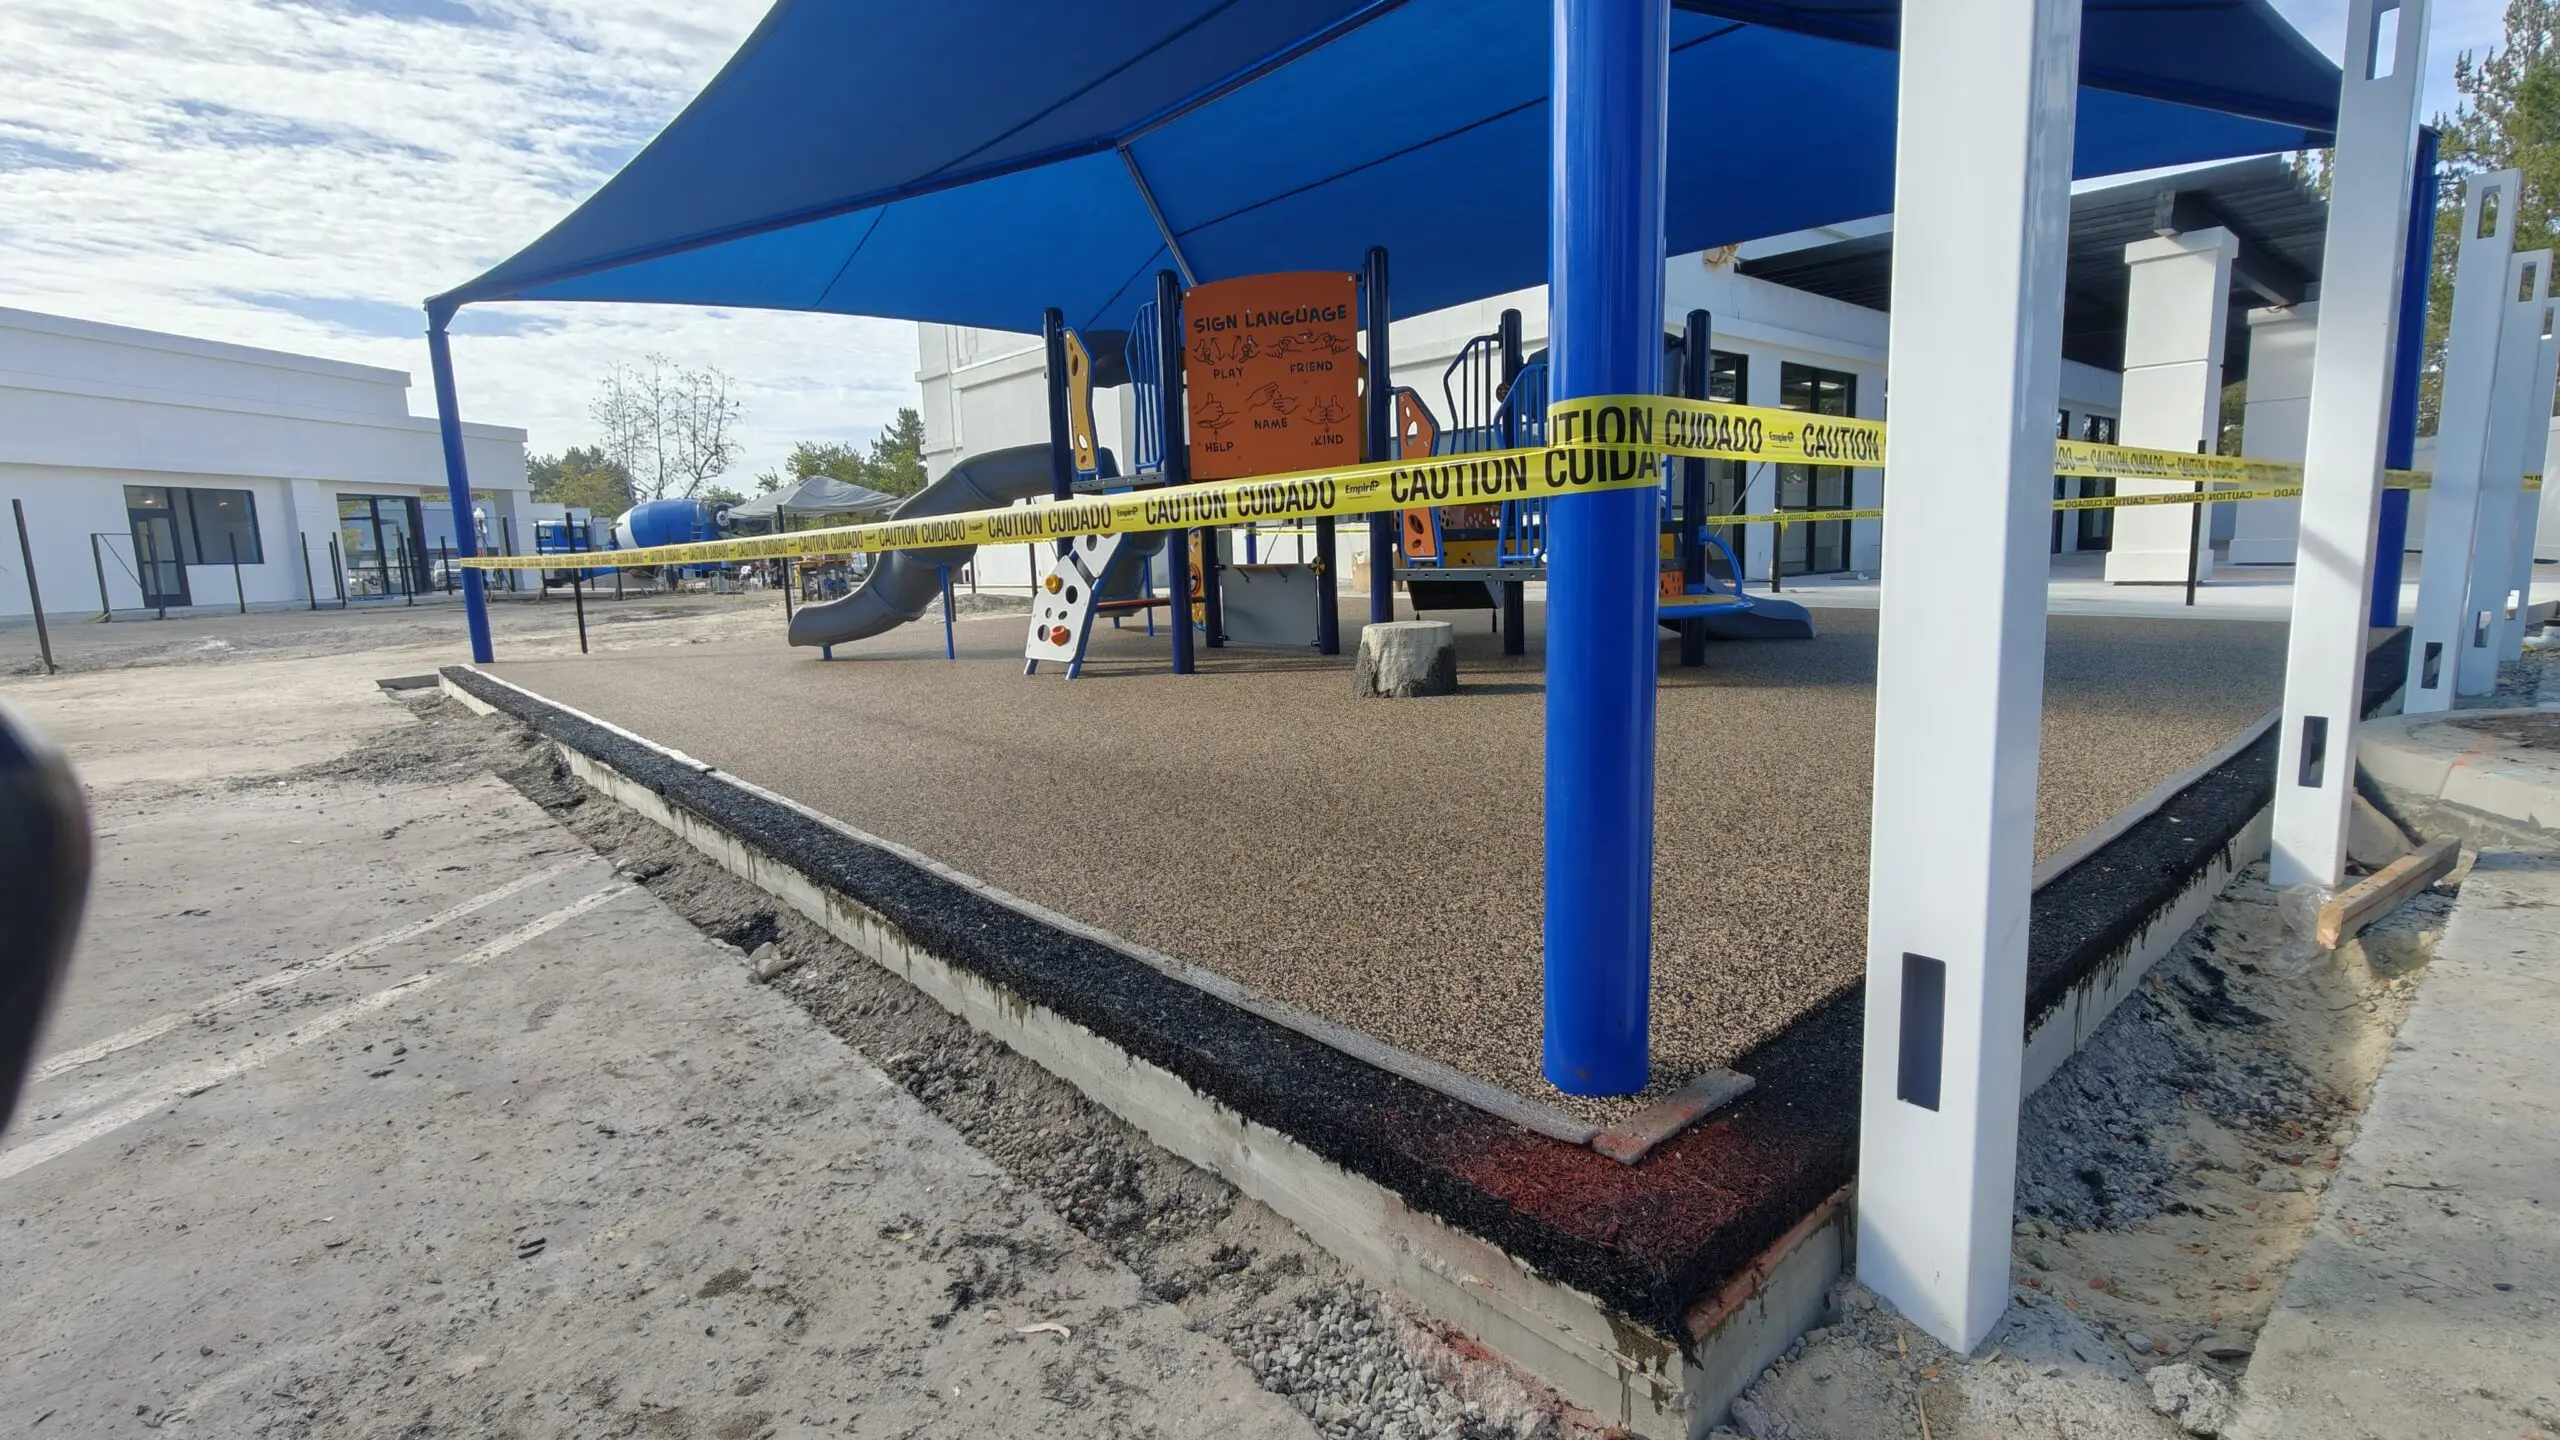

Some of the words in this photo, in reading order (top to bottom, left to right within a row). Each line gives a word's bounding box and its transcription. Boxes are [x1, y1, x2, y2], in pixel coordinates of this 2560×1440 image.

[1193, 314, 1237, 333] SIGN
[1245, 304, 1347, 328] LANGUAGE
[1213, 367, 1244, 379] PLAY
[1290, 361, 1333, 374] FRIEND
[1254, 417, 1288, 429] NAME
[1547, 406, 1653, 447] TION
[1664, 408, 1763, 454] CUIDADO
[1802, 423, 1880, 461] CAUTION
[1314, 434, 1344, 446] KIND
[1205, 442, 1234, 452] HELP
[799, 535, 829, 553] CAUTION
[830, 530, 864, 549] CUIDADO
[878, 523, 919, 547] CAUTION
[921, 519, 966, 543] CUIDADO
[987, 511, 1043, 539] CAUTION
[1048, 502, 1112, 533] CUIDADO
[1145, 489, 1227, 525] CAUTION
[1236, 477, 1336, 517] CUIDADO
[1390, 455, 1528, 503] CAUTION
[1545, 448, 1661, 488] CUIDA
